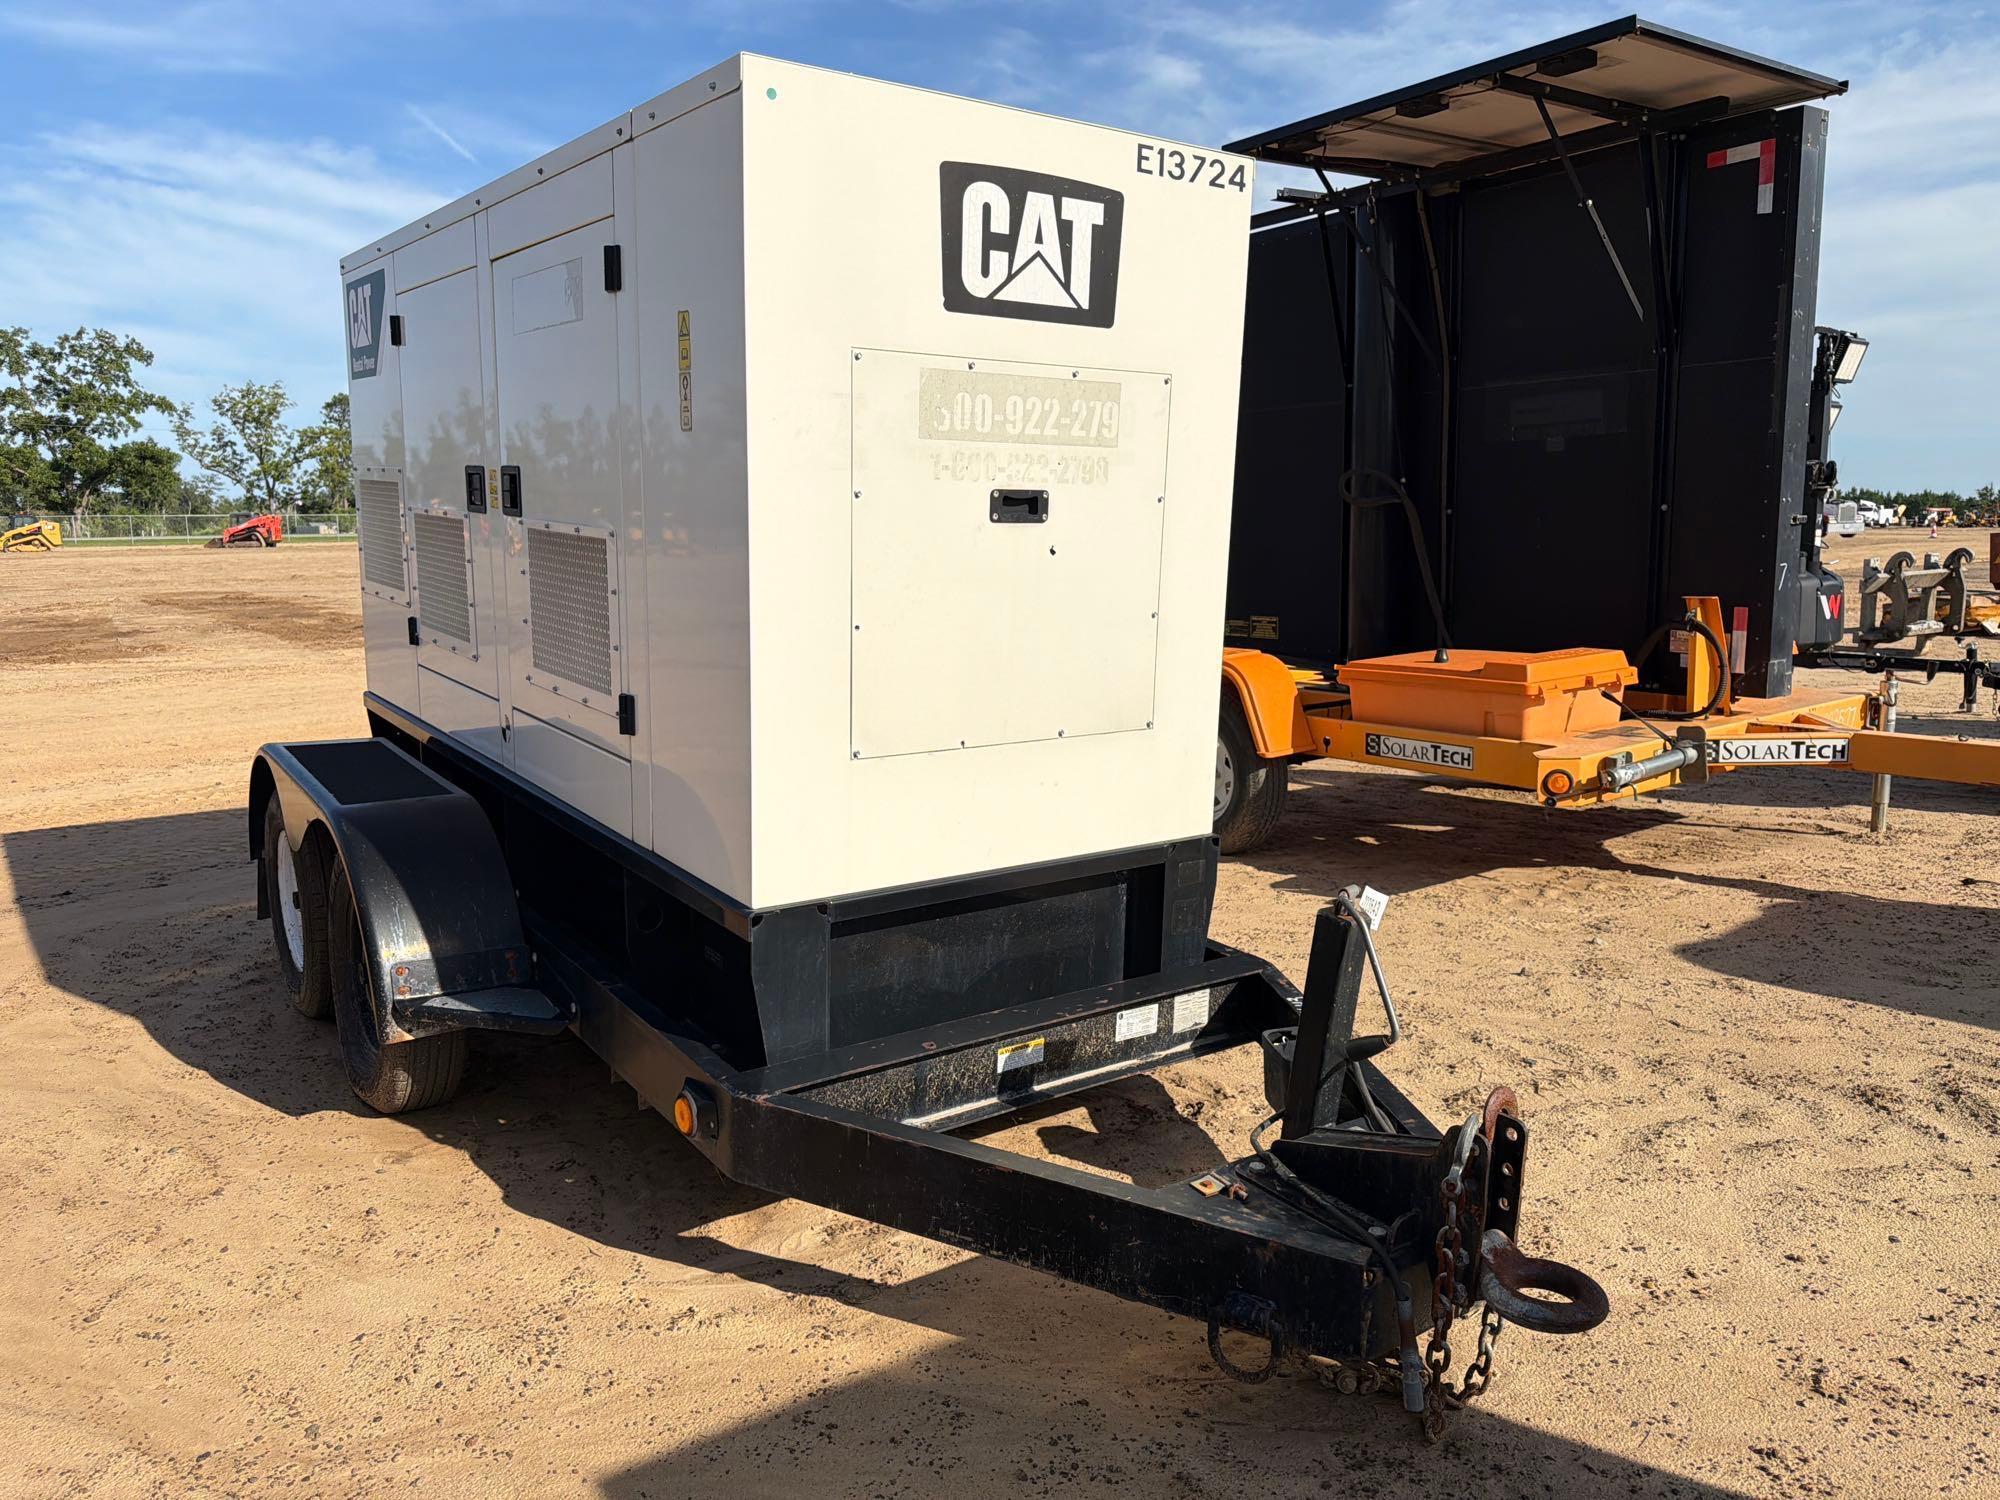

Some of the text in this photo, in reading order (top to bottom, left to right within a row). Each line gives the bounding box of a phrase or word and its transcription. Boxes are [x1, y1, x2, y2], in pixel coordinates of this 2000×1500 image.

[1137, 143, 1246, 192] E13724
[961, 181, 1105, 310] CAT
[349, 283, 372, 349] CAT
